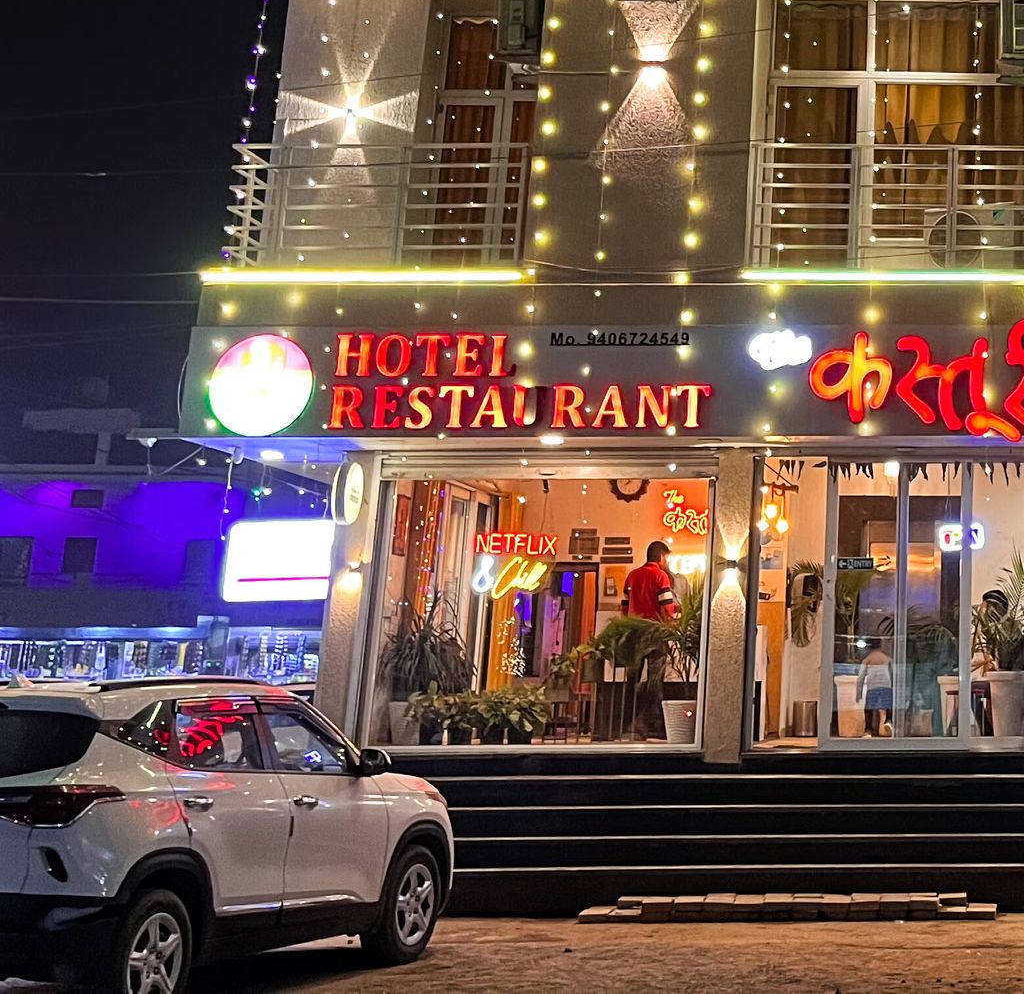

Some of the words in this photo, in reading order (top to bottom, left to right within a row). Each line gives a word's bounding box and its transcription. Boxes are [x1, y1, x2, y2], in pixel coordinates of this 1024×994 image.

[550, 332, 580, 345] Mo.
[587, 332, 690, 345] 9406724549
[334, 332, 516, 377] HOTEL
[327, 383, 712, 429] RESTAURANT
[663, 489, 684, 504] The
[475, 533, 557, 555] NETFLIX
